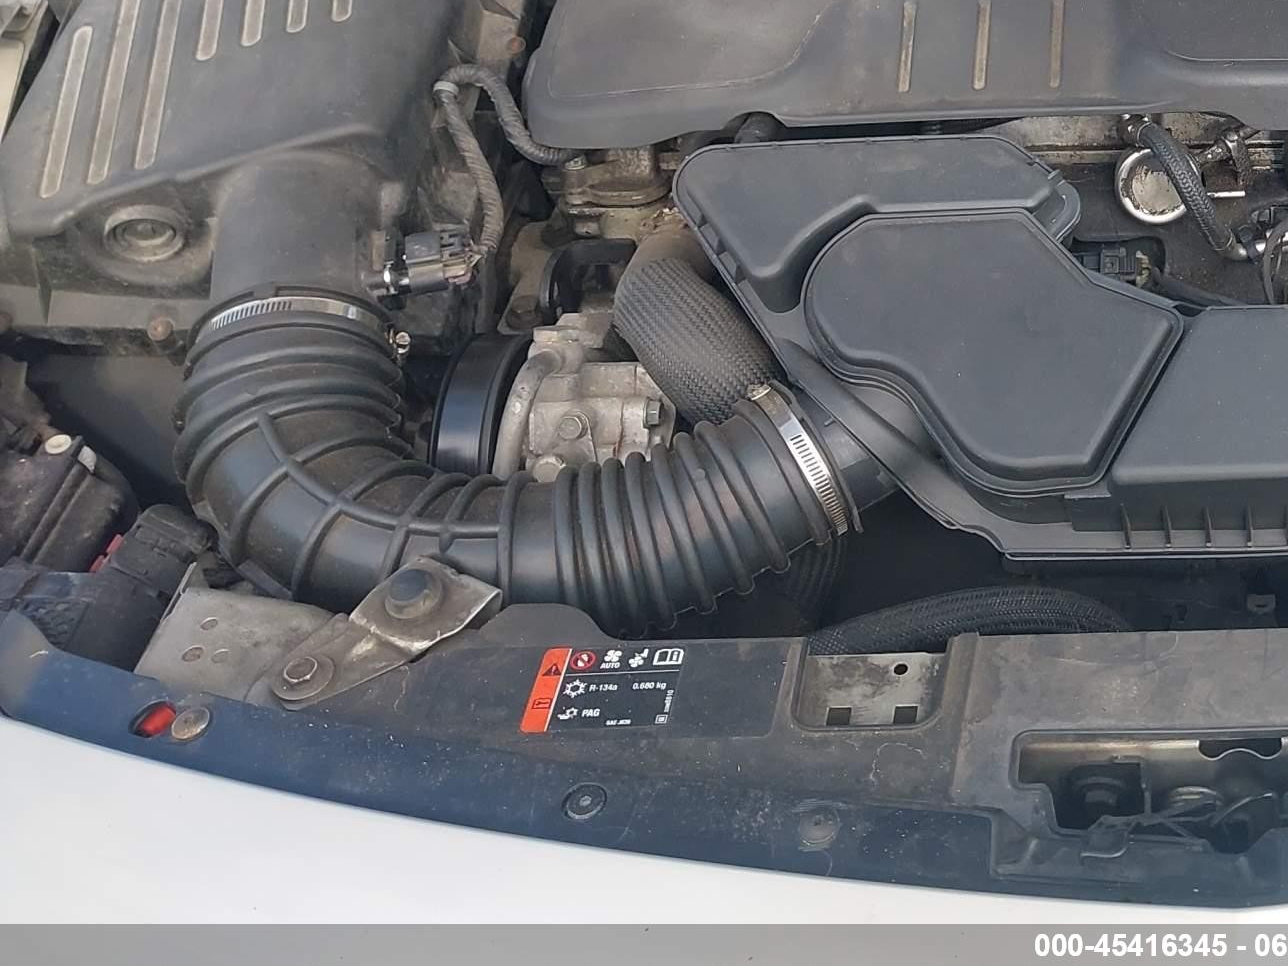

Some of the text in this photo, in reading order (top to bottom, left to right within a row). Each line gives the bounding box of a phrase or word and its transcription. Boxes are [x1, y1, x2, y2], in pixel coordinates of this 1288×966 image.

[589, 682, 667, 692] R-134a 0.680 kg
[581, 709, 600, 718] PAG
